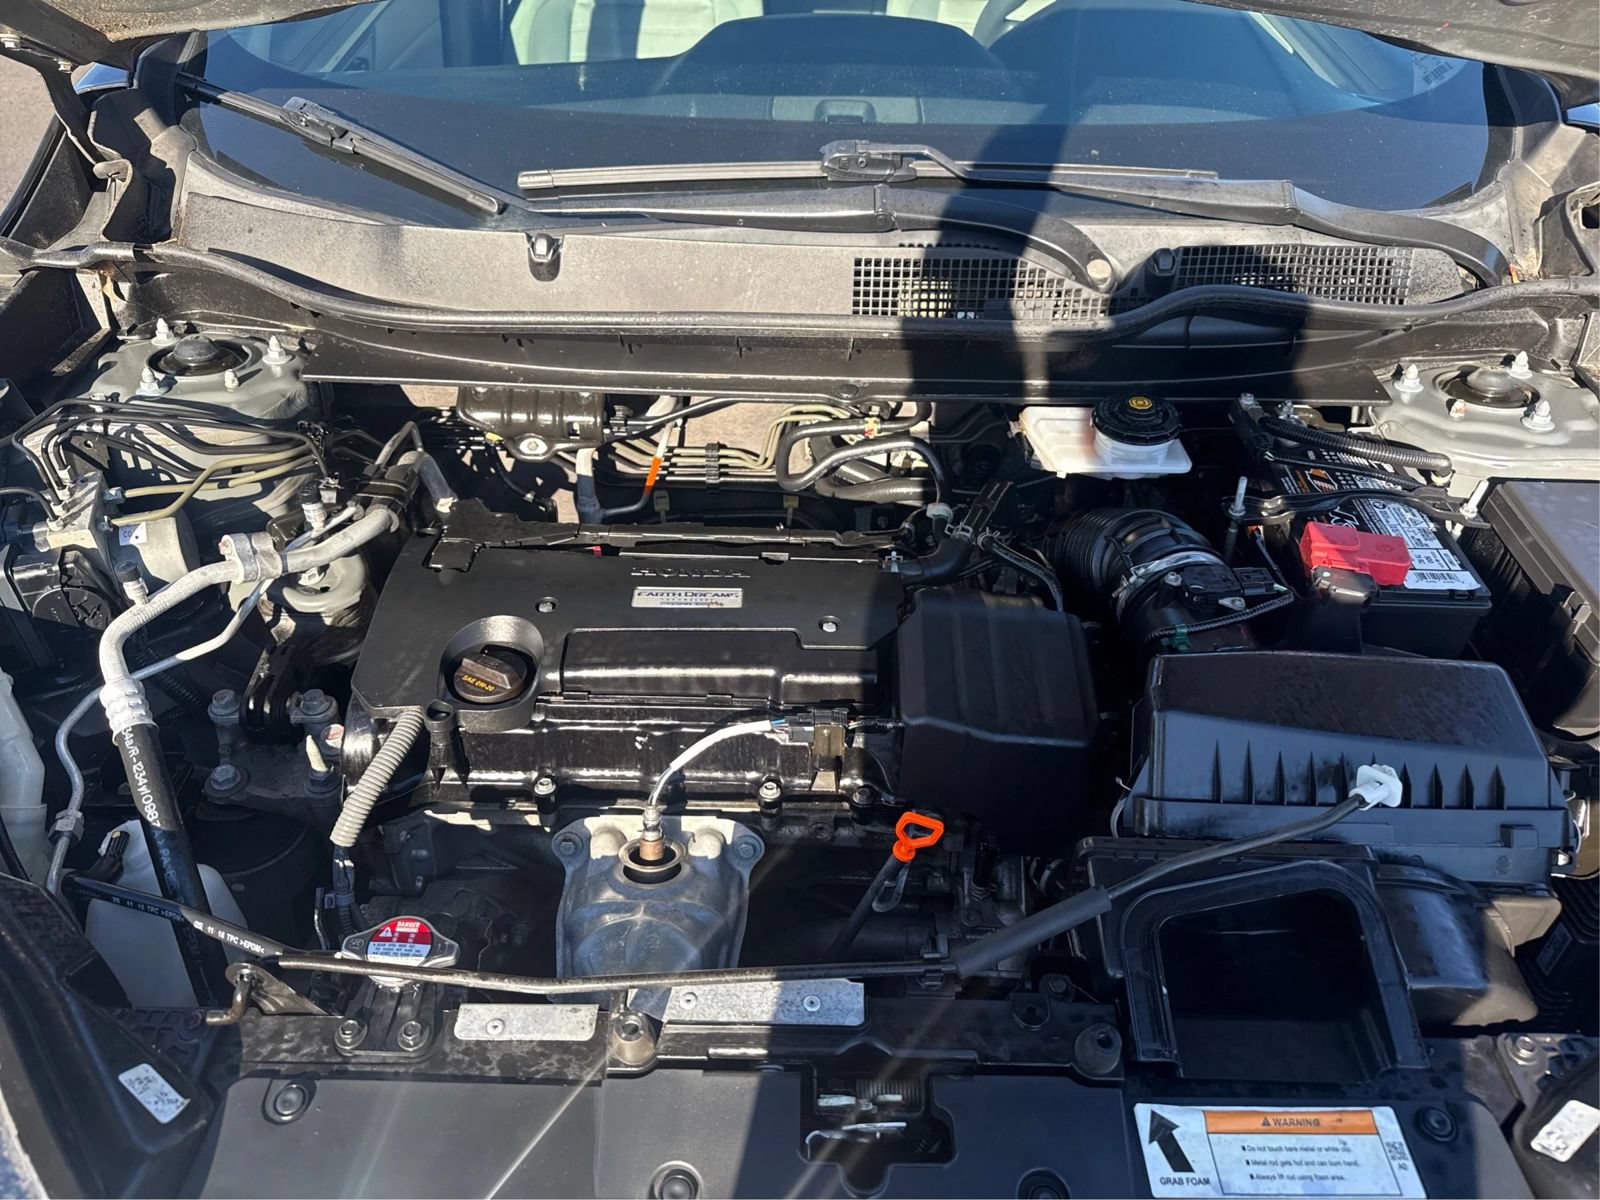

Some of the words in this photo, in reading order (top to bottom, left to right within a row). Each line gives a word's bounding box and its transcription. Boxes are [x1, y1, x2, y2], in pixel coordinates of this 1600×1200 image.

[462, 674, 477, 684] SAE
[1272, 1118, 1320, 1127] WARNING
[1159, 1176, 1185, 1186] GRAB
[1185, 1176, 1211, 1186] FOAM
